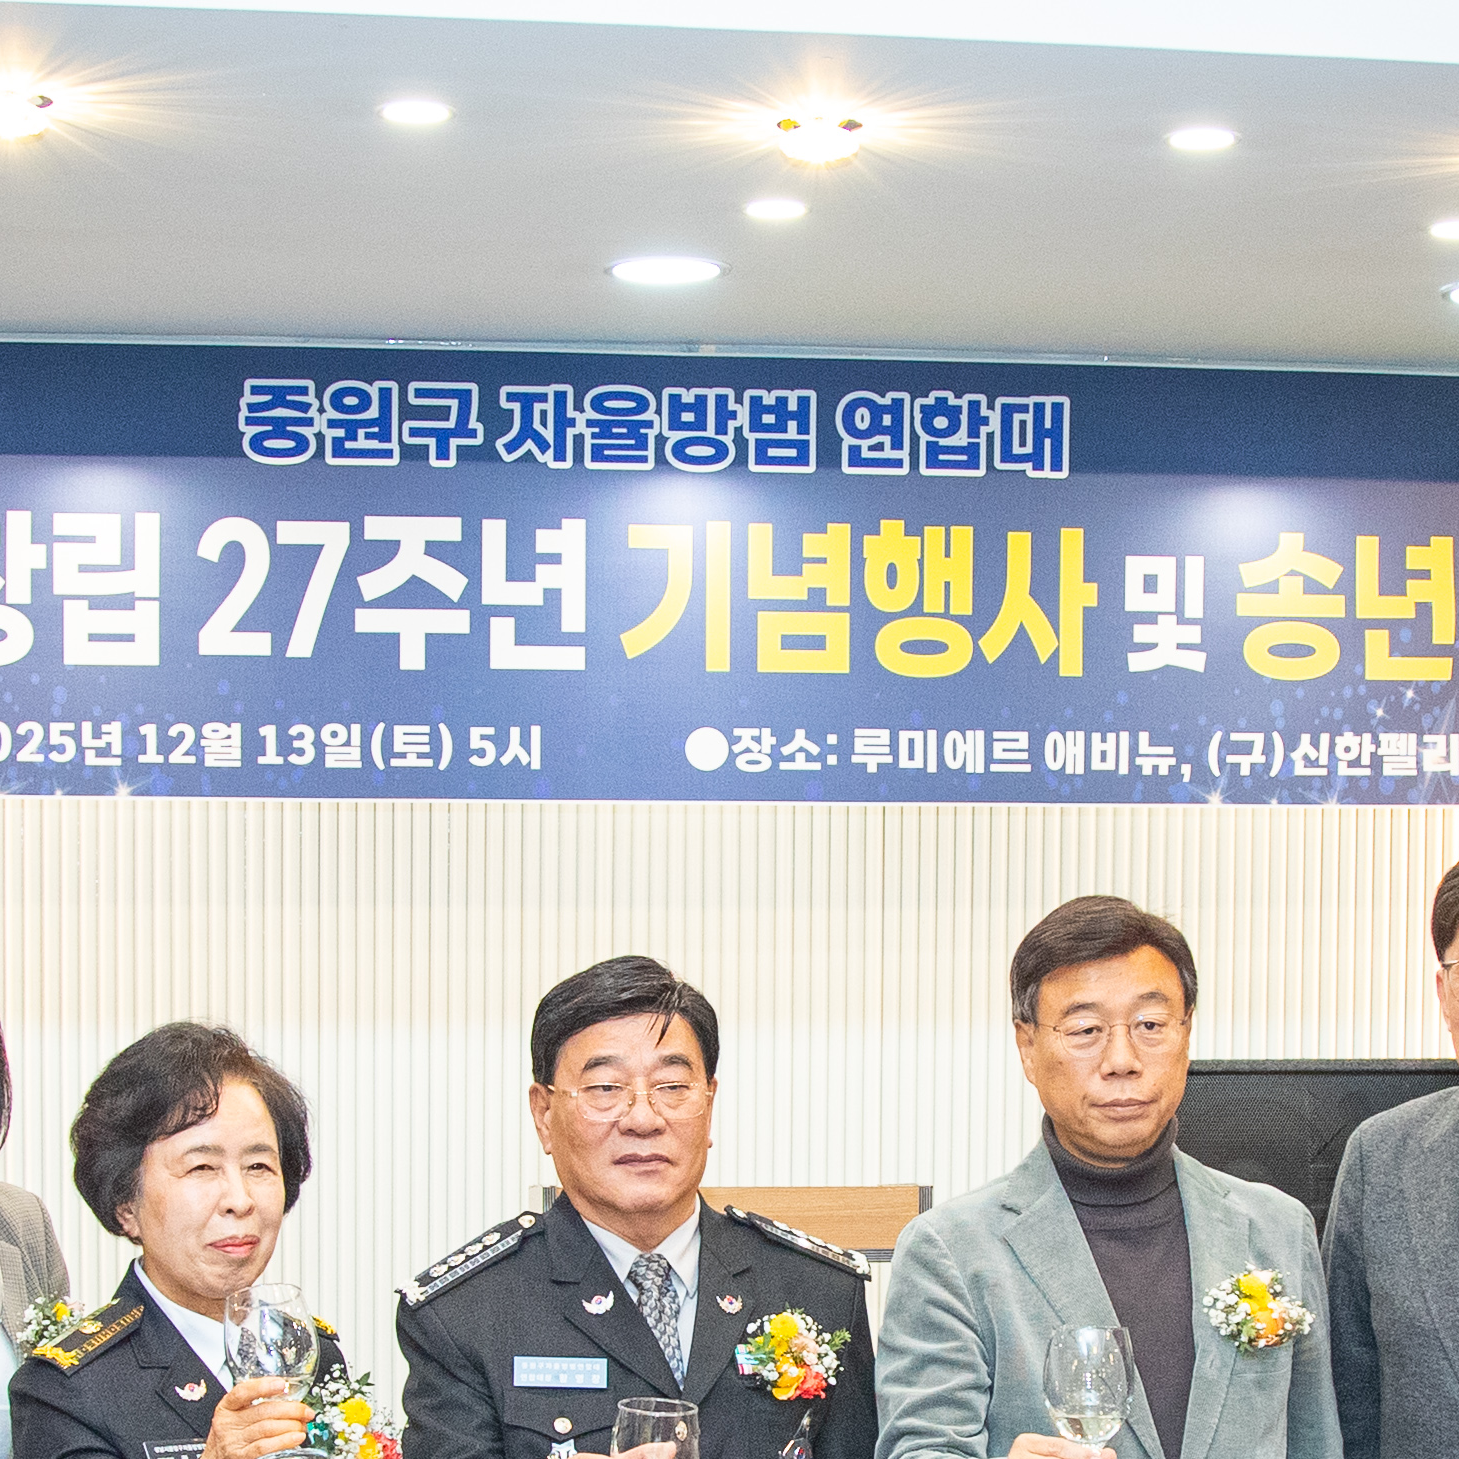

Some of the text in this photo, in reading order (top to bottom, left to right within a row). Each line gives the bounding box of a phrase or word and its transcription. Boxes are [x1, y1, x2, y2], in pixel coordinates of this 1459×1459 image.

[238, 377, 1070, 479] 중원구 자율방범 연합대
[197, 514, 587, 672] 27주년
[620, 518, 1098, 678] 기념행사
[1124, 554, 1209, 674] 및
[137, 721, 242, 768] 12월
[257, 721, 453, 771] 13일(토)
[468, 725, 542, 770] 5시
[731, 727, 838, 773] 장소:
[851, 728, 1032, 774] 루미에르
[1044, 730, 1192, 783] 애비뉴,
